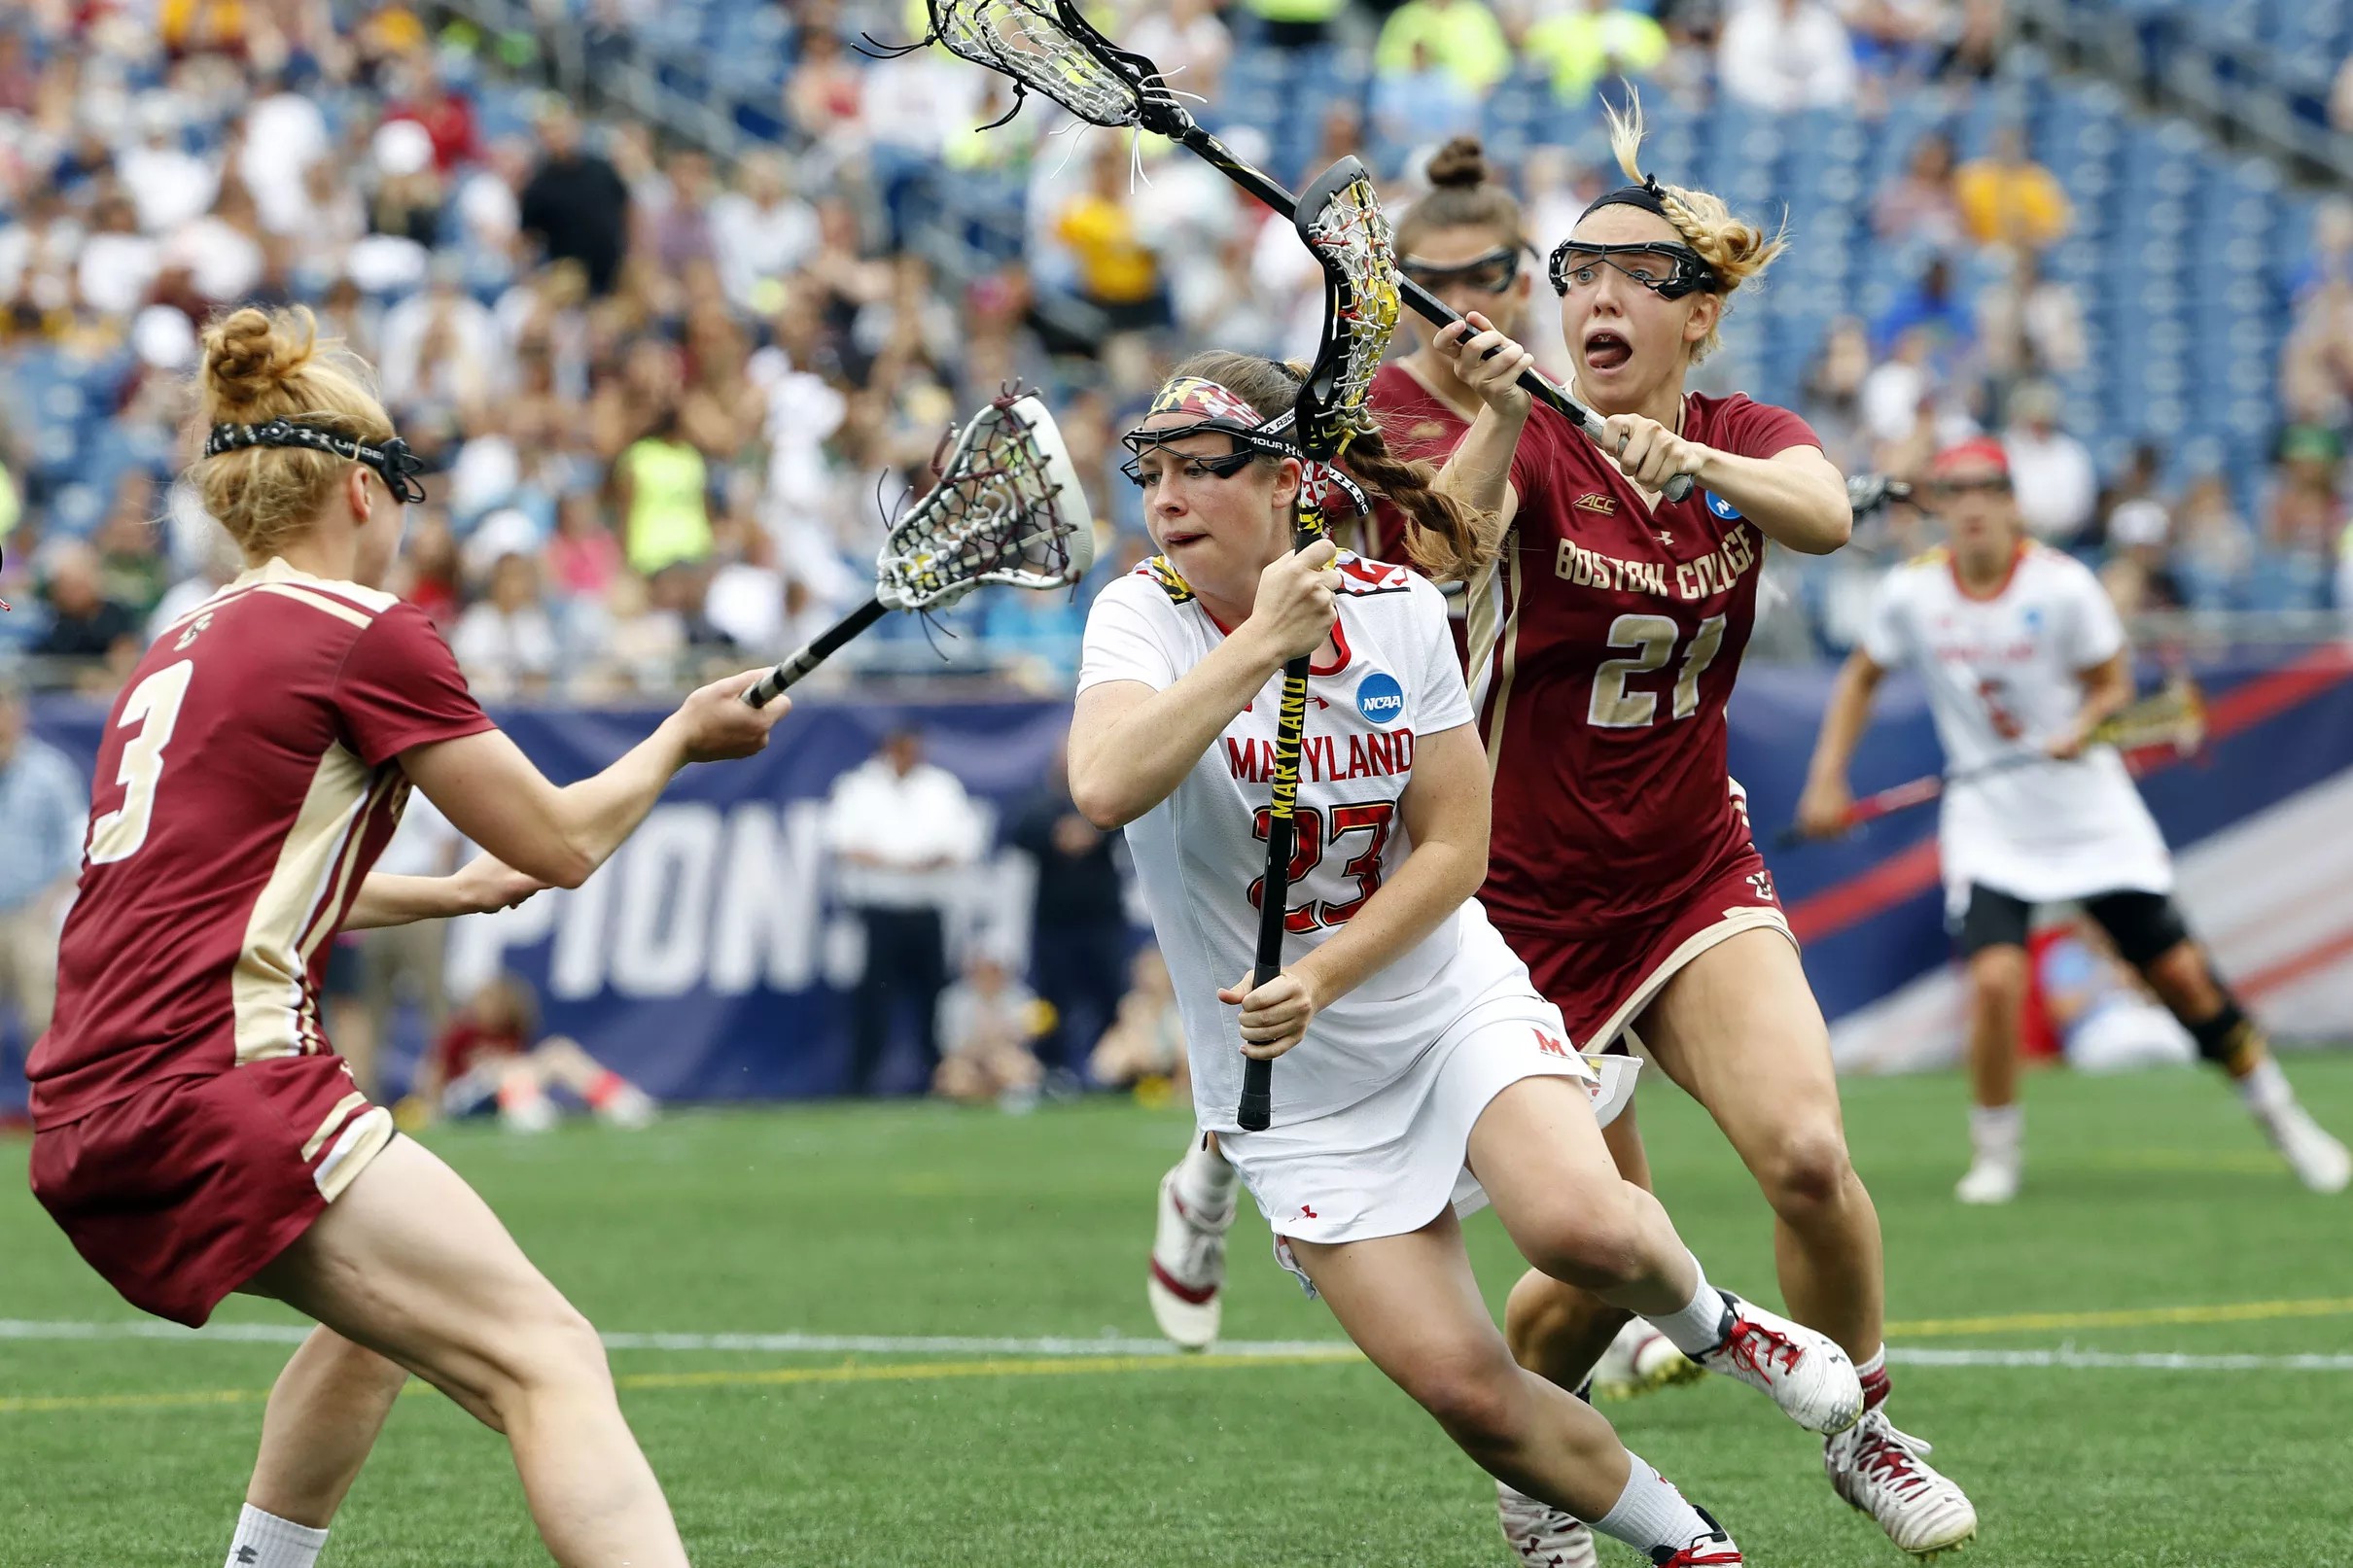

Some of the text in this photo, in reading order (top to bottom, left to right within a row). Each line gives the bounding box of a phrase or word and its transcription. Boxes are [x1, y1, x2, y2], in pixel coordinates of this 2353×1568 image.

[1577, 494, 1617, 511] ACC
[1556, 538, 1668, 598] BOSTON
[1363, 695, 1402, 712] NCAA
[1587, 612, 1727, 727] 21
[87, 658, 193, 865] 3
[1226, 727, 1416, 784] MAYLAND
[1270, 676, 1306, 819] MARYLAND
[442, 799, 871, 1003] PION
[1246, 799, 1397, 935] 23
[1530, 1028, 1570, 1058] M
